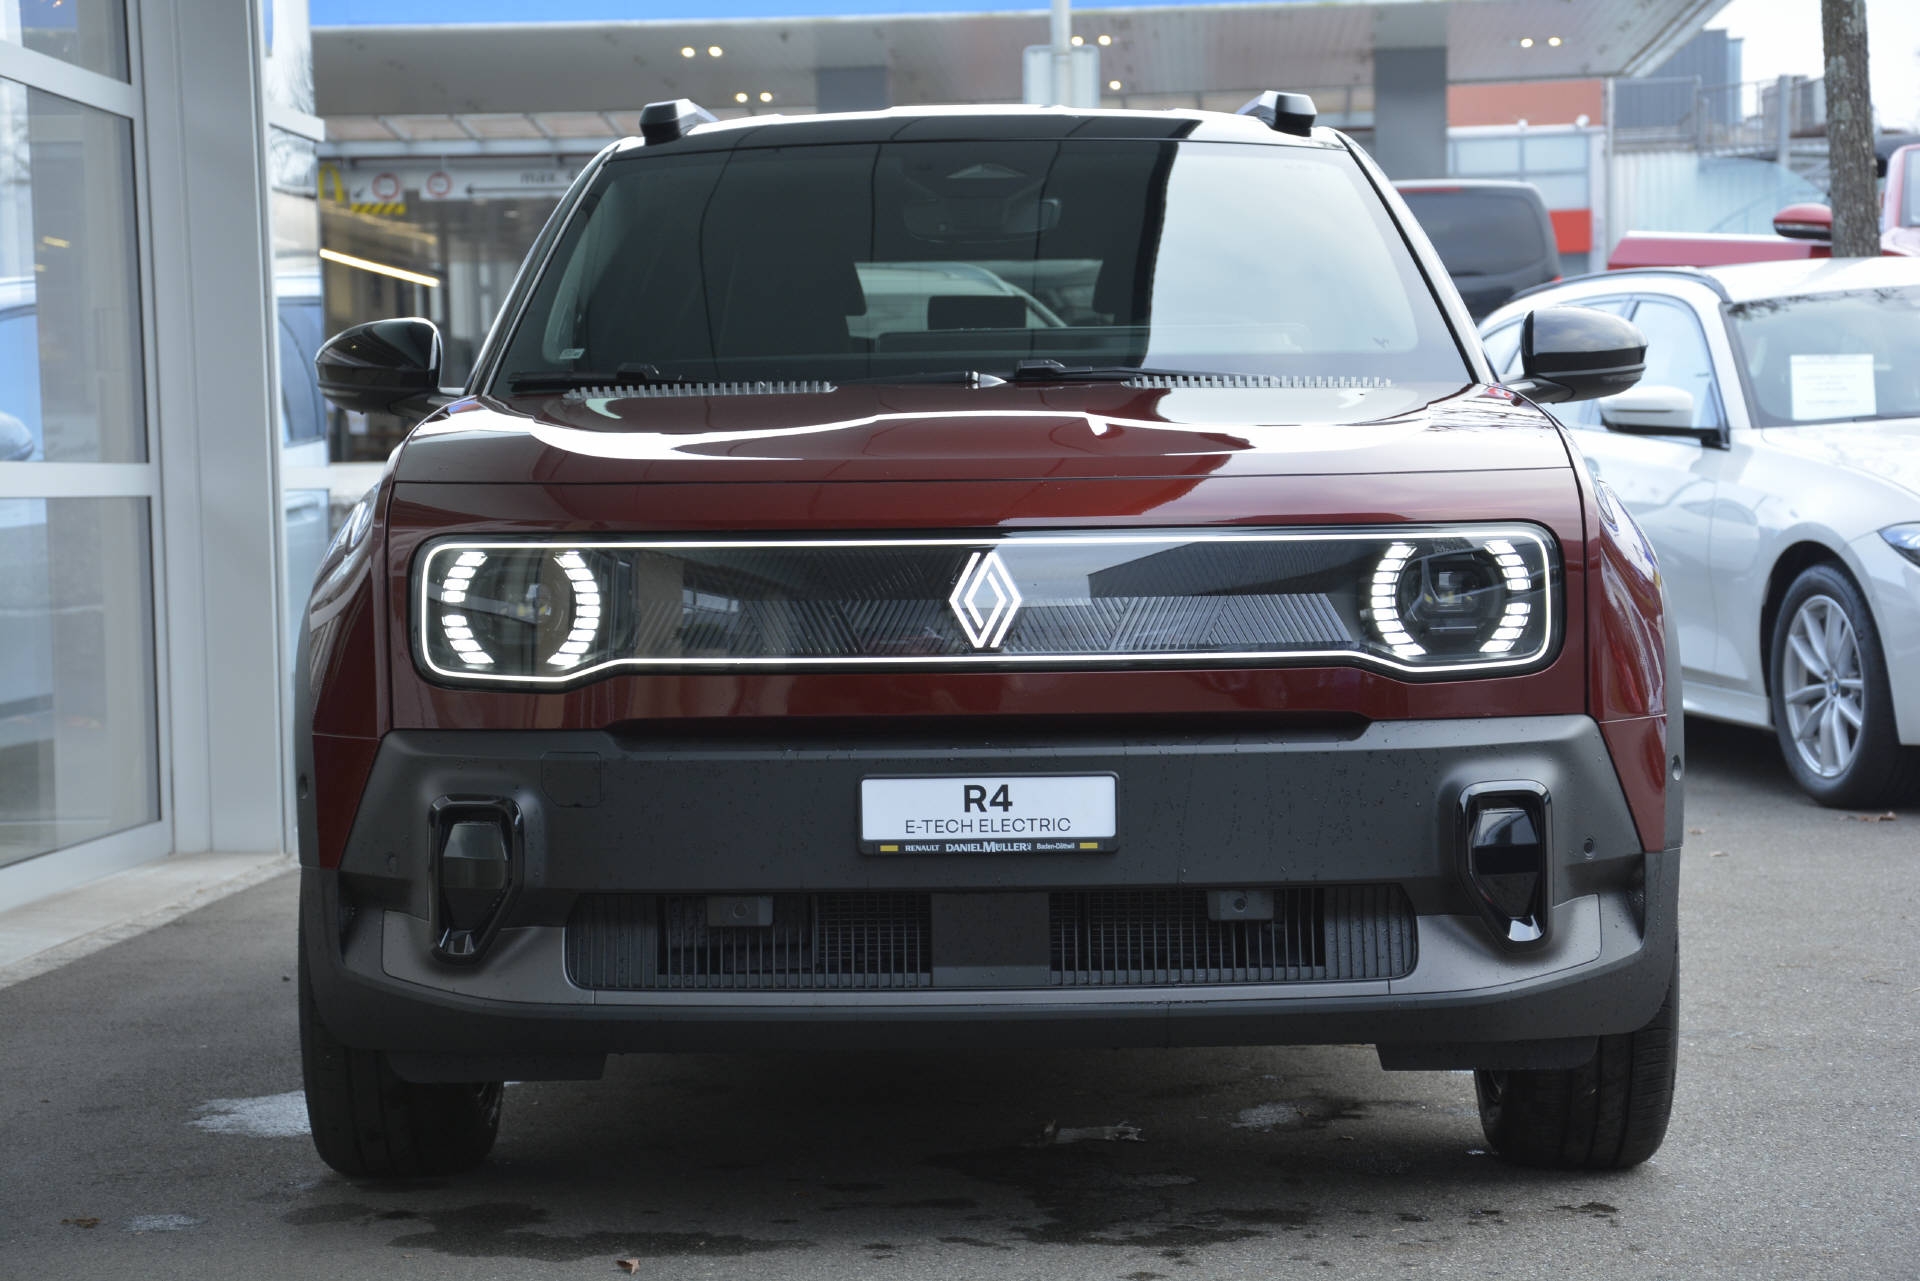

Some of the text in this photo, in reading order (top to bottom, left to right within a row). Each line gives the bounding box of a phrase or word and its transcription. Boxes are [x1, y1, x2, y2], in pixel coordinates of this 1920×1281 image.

[963, 784, 1013, 813] R4
[905, 818, 1072, 834] E-TECH ELECTRIC
[905, 844, 940, 852] RENAULT
